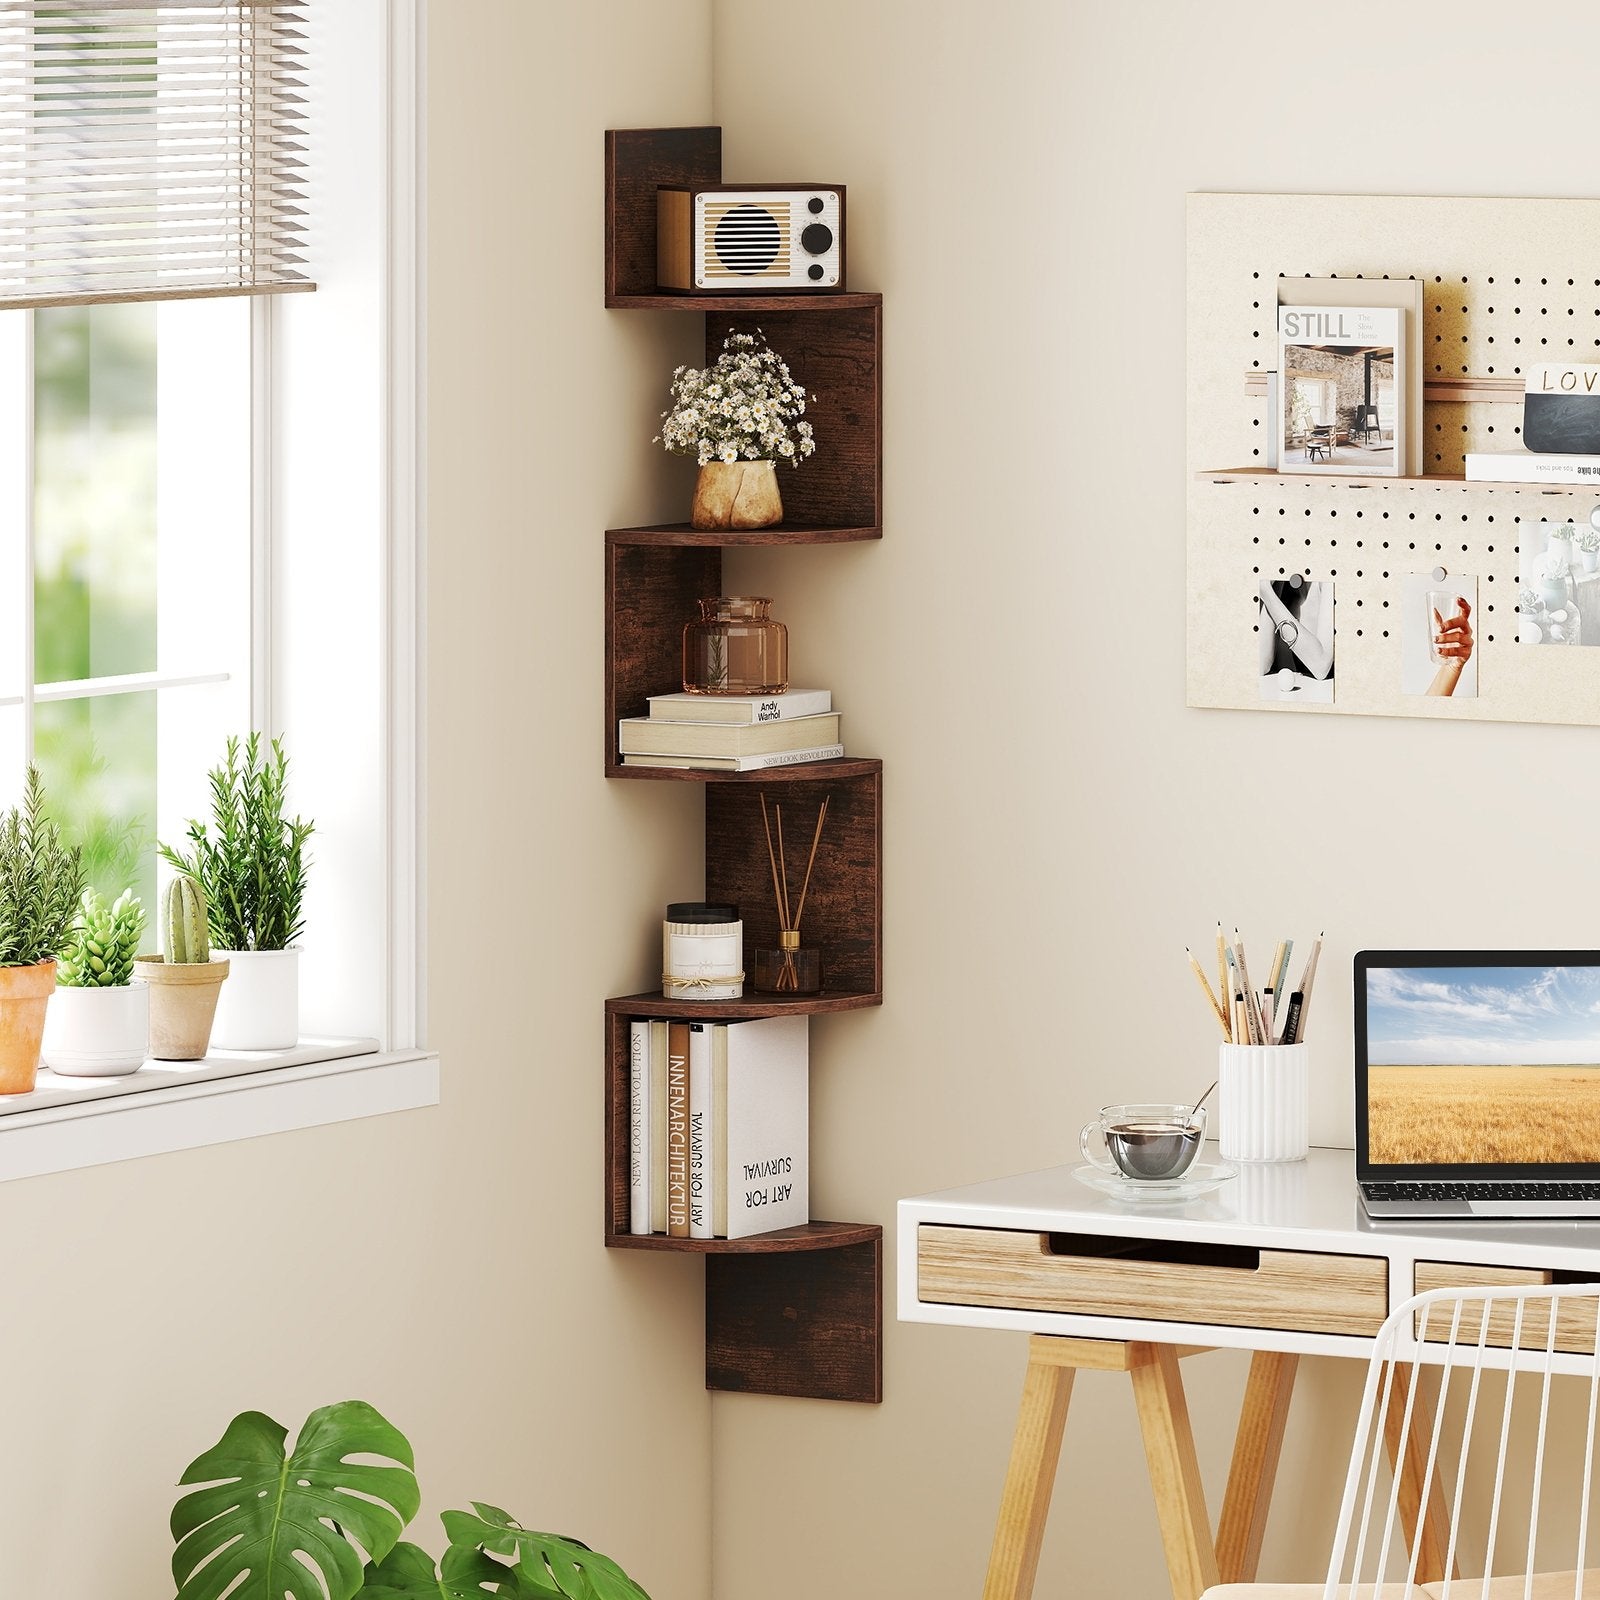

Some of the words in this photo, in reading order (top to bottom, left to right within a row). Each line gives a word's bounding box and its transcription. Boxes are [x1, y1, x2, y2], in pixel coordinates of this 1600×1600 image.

[1284, 312, 1351, 337] STILL
[1543, 371, 1598, 392] LOV
[1577, 466, 1591, 475] bike
[757, 710, 781, 721] Warhol
[760, 701, 778, 712] Andy
[764, 757, 779, 765] NEW
[780, 754, 799, 763] LOOK
[800, 748, 841, 760] REVOLUTION
[632, 1033, 641, 1115] REVOLUTION
[632, 1119, 641, 1154] LOOK
[670, 1055, 685, 1226] INNENARCHITEKTUR
[691, 1112, 703, 1168] SURVIVAL
[633, 1158, 641, 1187] NEW
[743, 1157, 792, 1180] SURVIVAL
[691, 1172, 703, 1198] FOR
[771, 1184, 792, 1203] ART
[745, 1189, 768, 1208] FOR
[691, 1203, 703, 1226] ART
